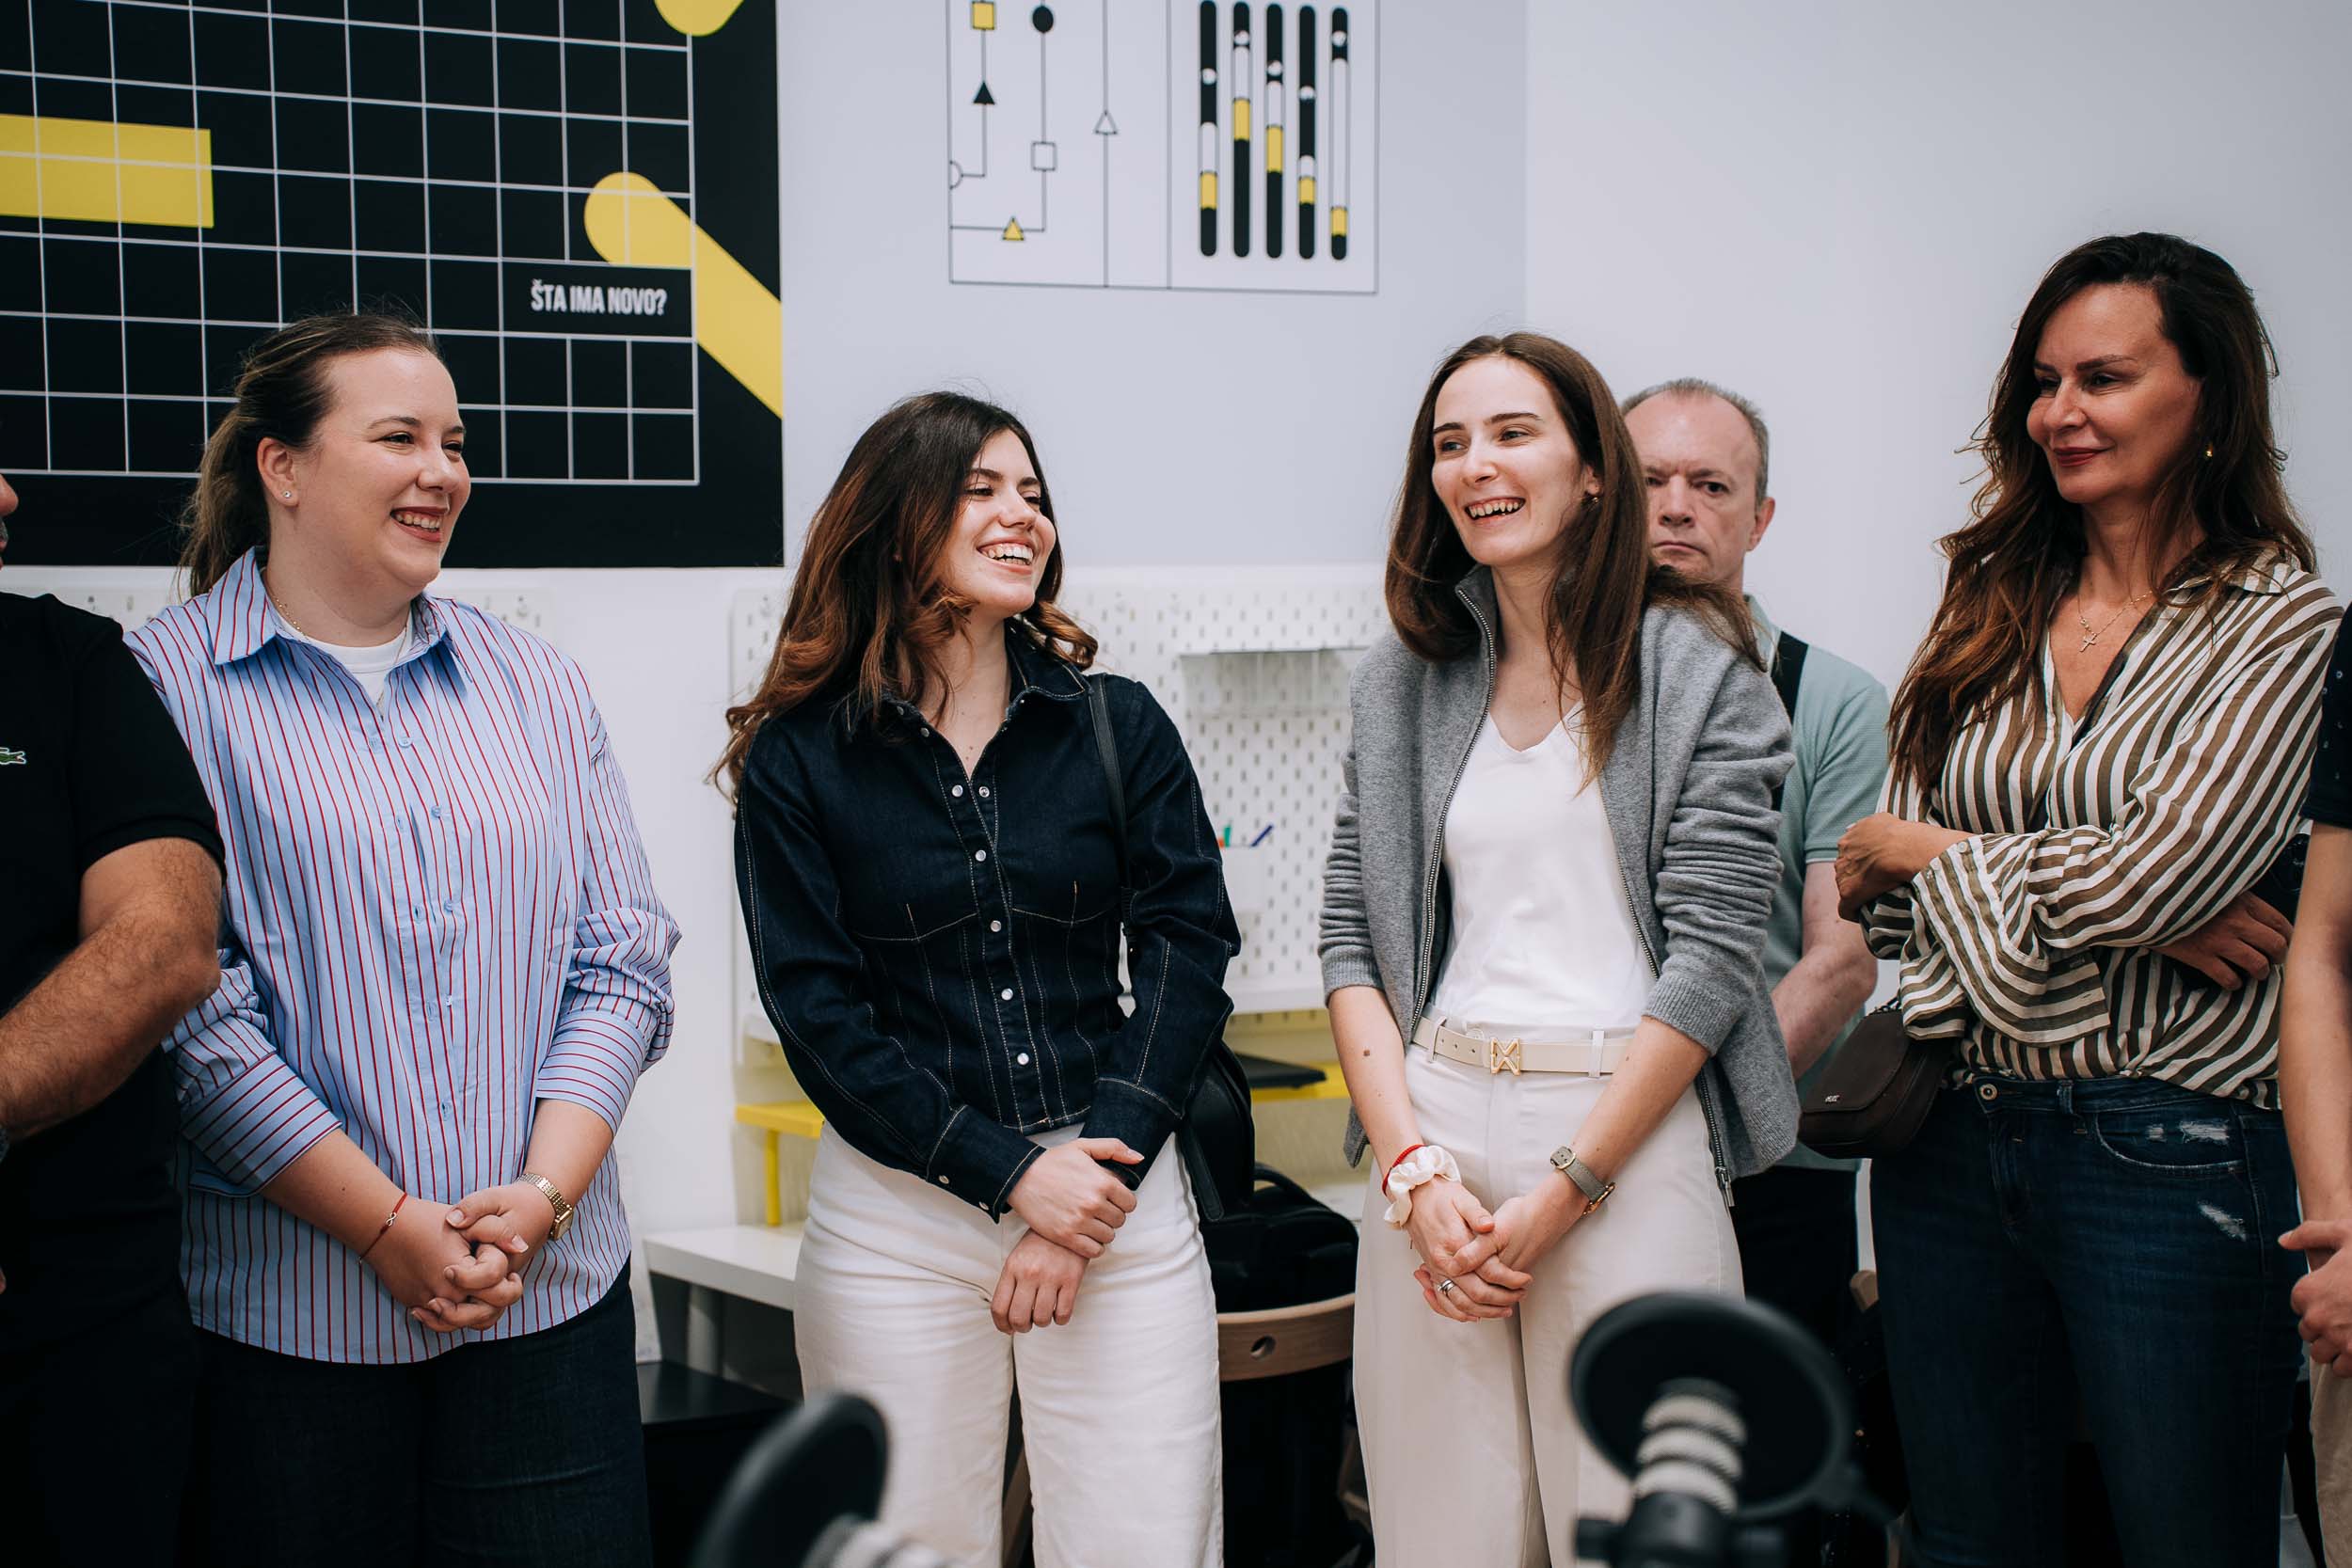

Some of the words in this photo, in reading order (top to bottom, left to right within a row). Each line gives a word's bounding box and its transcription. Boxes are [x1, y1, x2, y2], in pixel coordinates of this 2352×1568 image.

[531, 278, 567, 312] ŠTA
[569, 285, 605, 314] IMA
[608, 286, 667, 316] NOVO?
